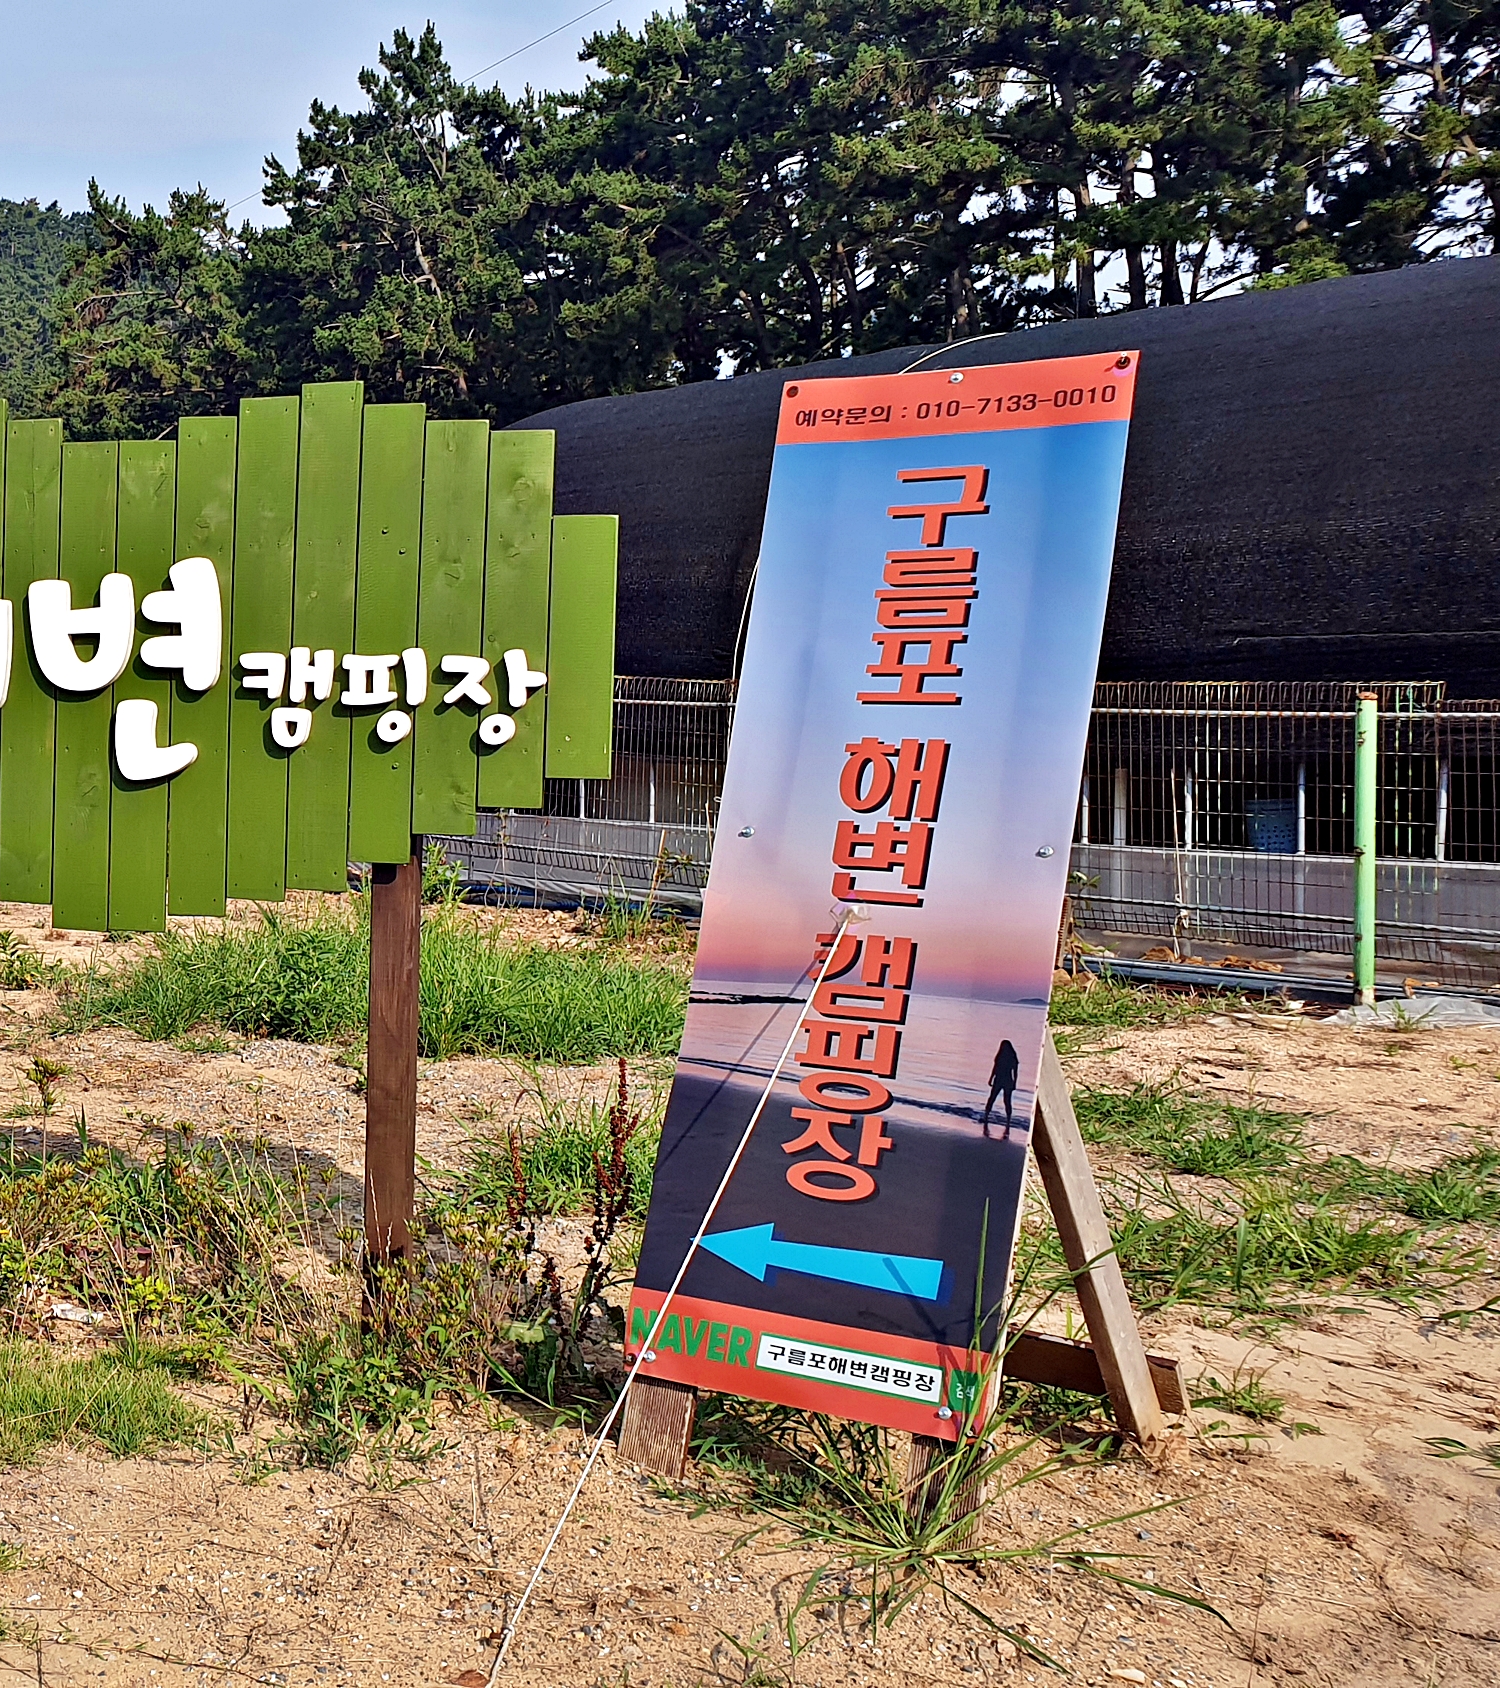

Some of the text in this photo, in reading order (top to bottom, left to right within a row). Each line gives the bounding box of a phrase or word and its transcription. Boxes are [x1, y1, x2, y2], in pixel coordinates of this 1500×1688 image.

[795, 404, 893, 428] 예약문의
[916, 384, 1117, 420] 010-7133-0010
[238, 646, 548, 749] 캠핑장
[781, 464, 990, 1203] 구름포 해변 캠핑장
[630, 1307, 753, 1368] NAVER
[767, 1343, 937, 1393] 구름포해변캠핑장
